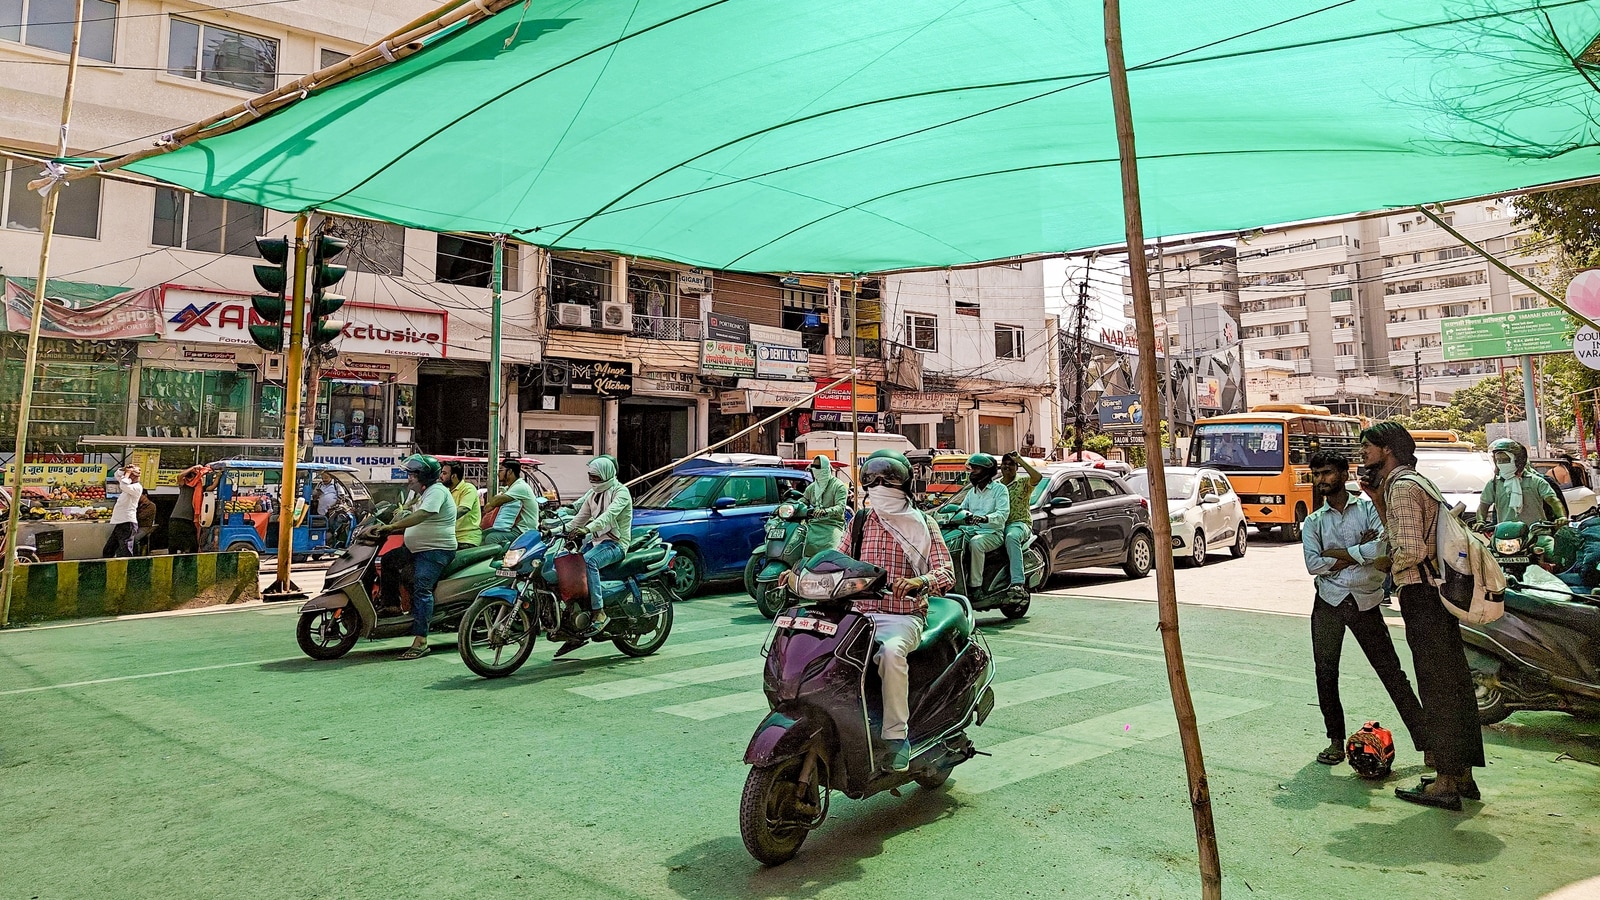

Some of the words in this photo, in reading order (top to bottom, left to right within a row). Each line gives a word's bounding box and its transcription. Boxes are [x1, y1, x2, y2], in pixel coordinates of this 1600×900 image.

[116, 310, 155, 323] SHOE
[1577, 332, 1600, 341] COU
[769, 348, 790, 361] DENTAL
[790, 350, 809, 362] CLINIC
[593, 377, 631, 395] Kitchen
[818, 413, 837, 422] safari
[857, 415, 875, 424] safari
[1114, 436, 1129, 444] SALON
